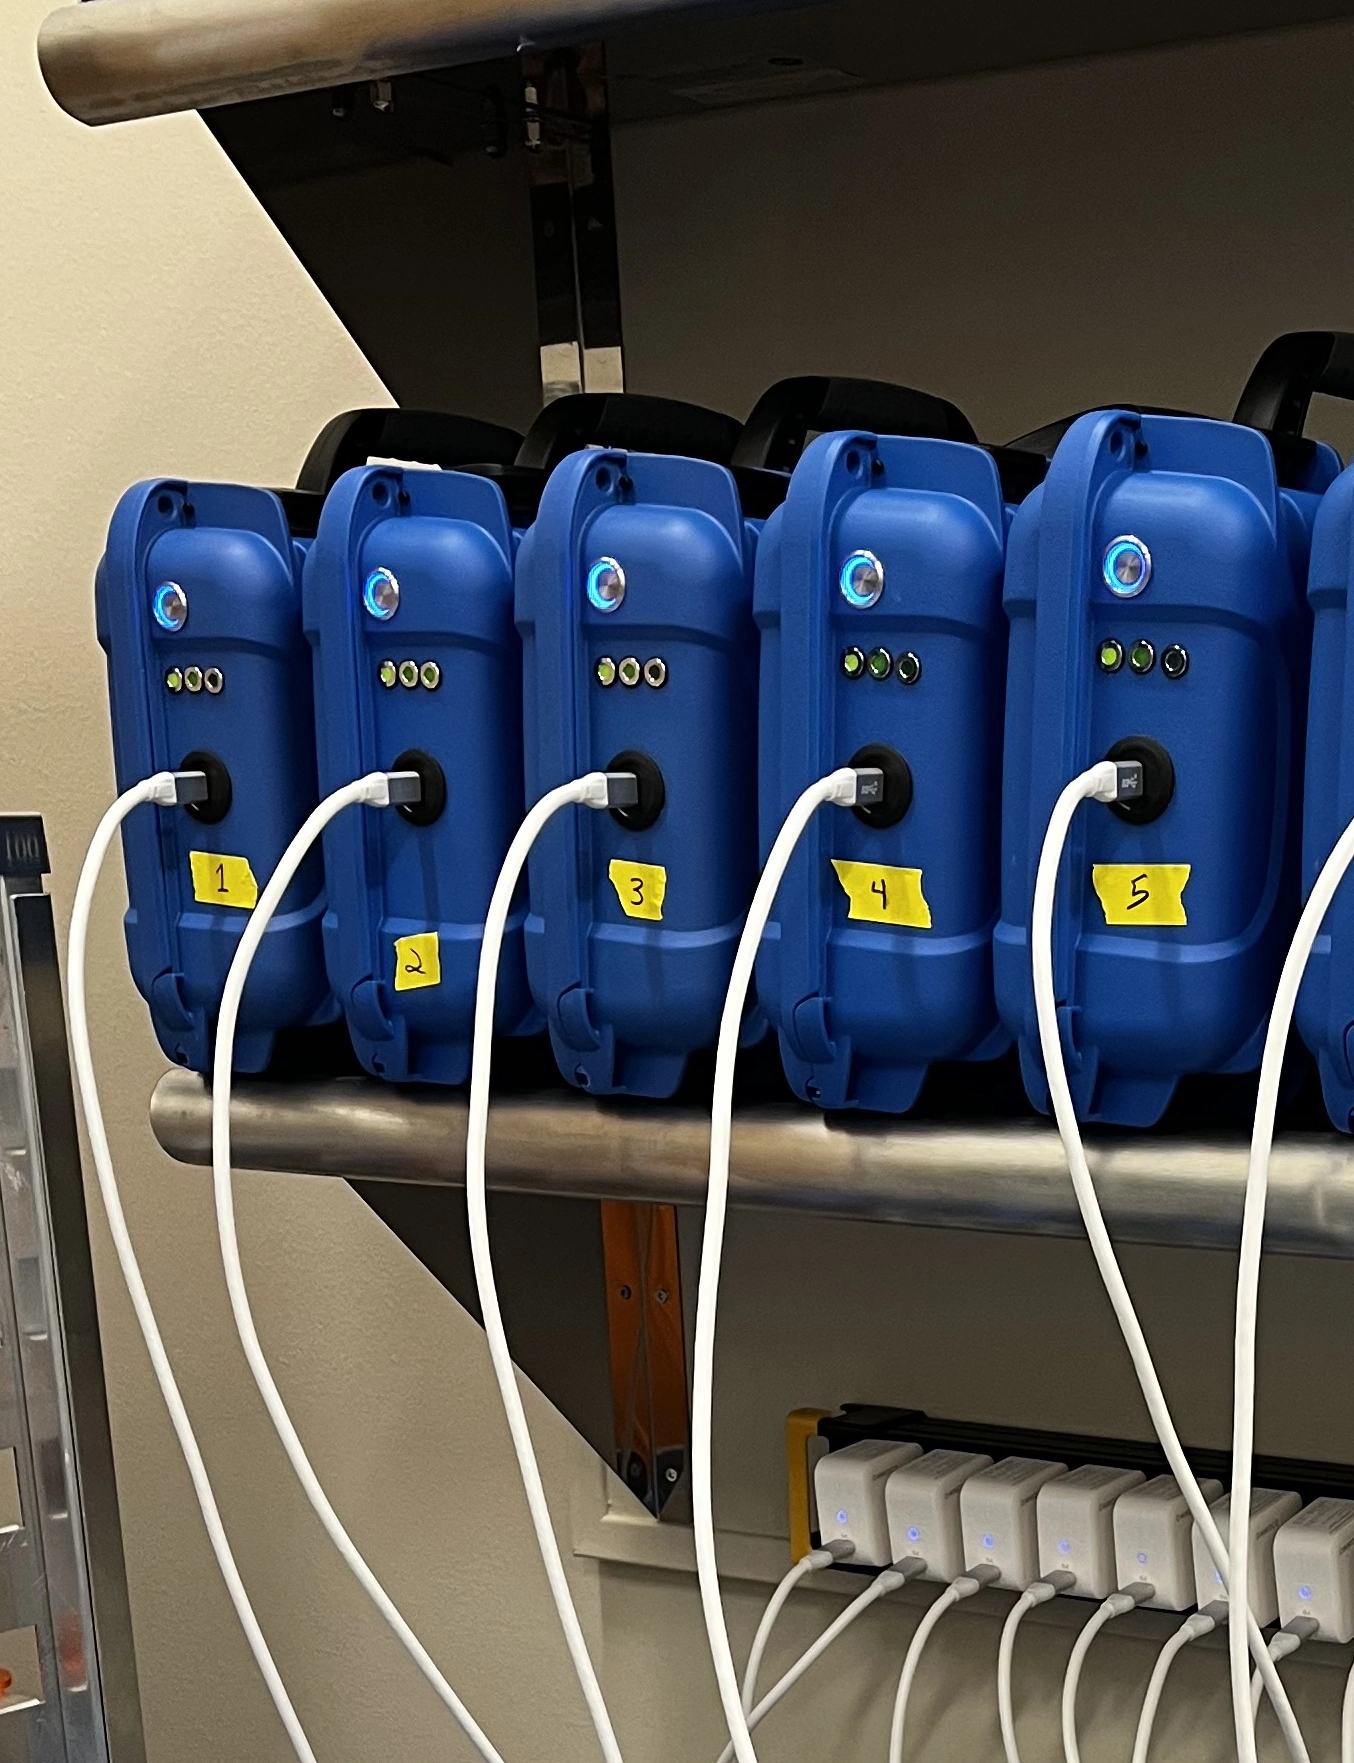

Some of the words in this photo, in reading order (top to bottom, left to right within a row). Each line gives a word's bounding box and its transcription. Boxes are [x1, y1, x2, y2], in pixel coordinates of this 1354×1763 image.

[215, 863, 229, 893] 1
[630, 877, 645, 906] 3
[1126, 873, 1150, 910] 5
[870, 878, 888, 910] 4
[404, 947, 427, 975] 2
